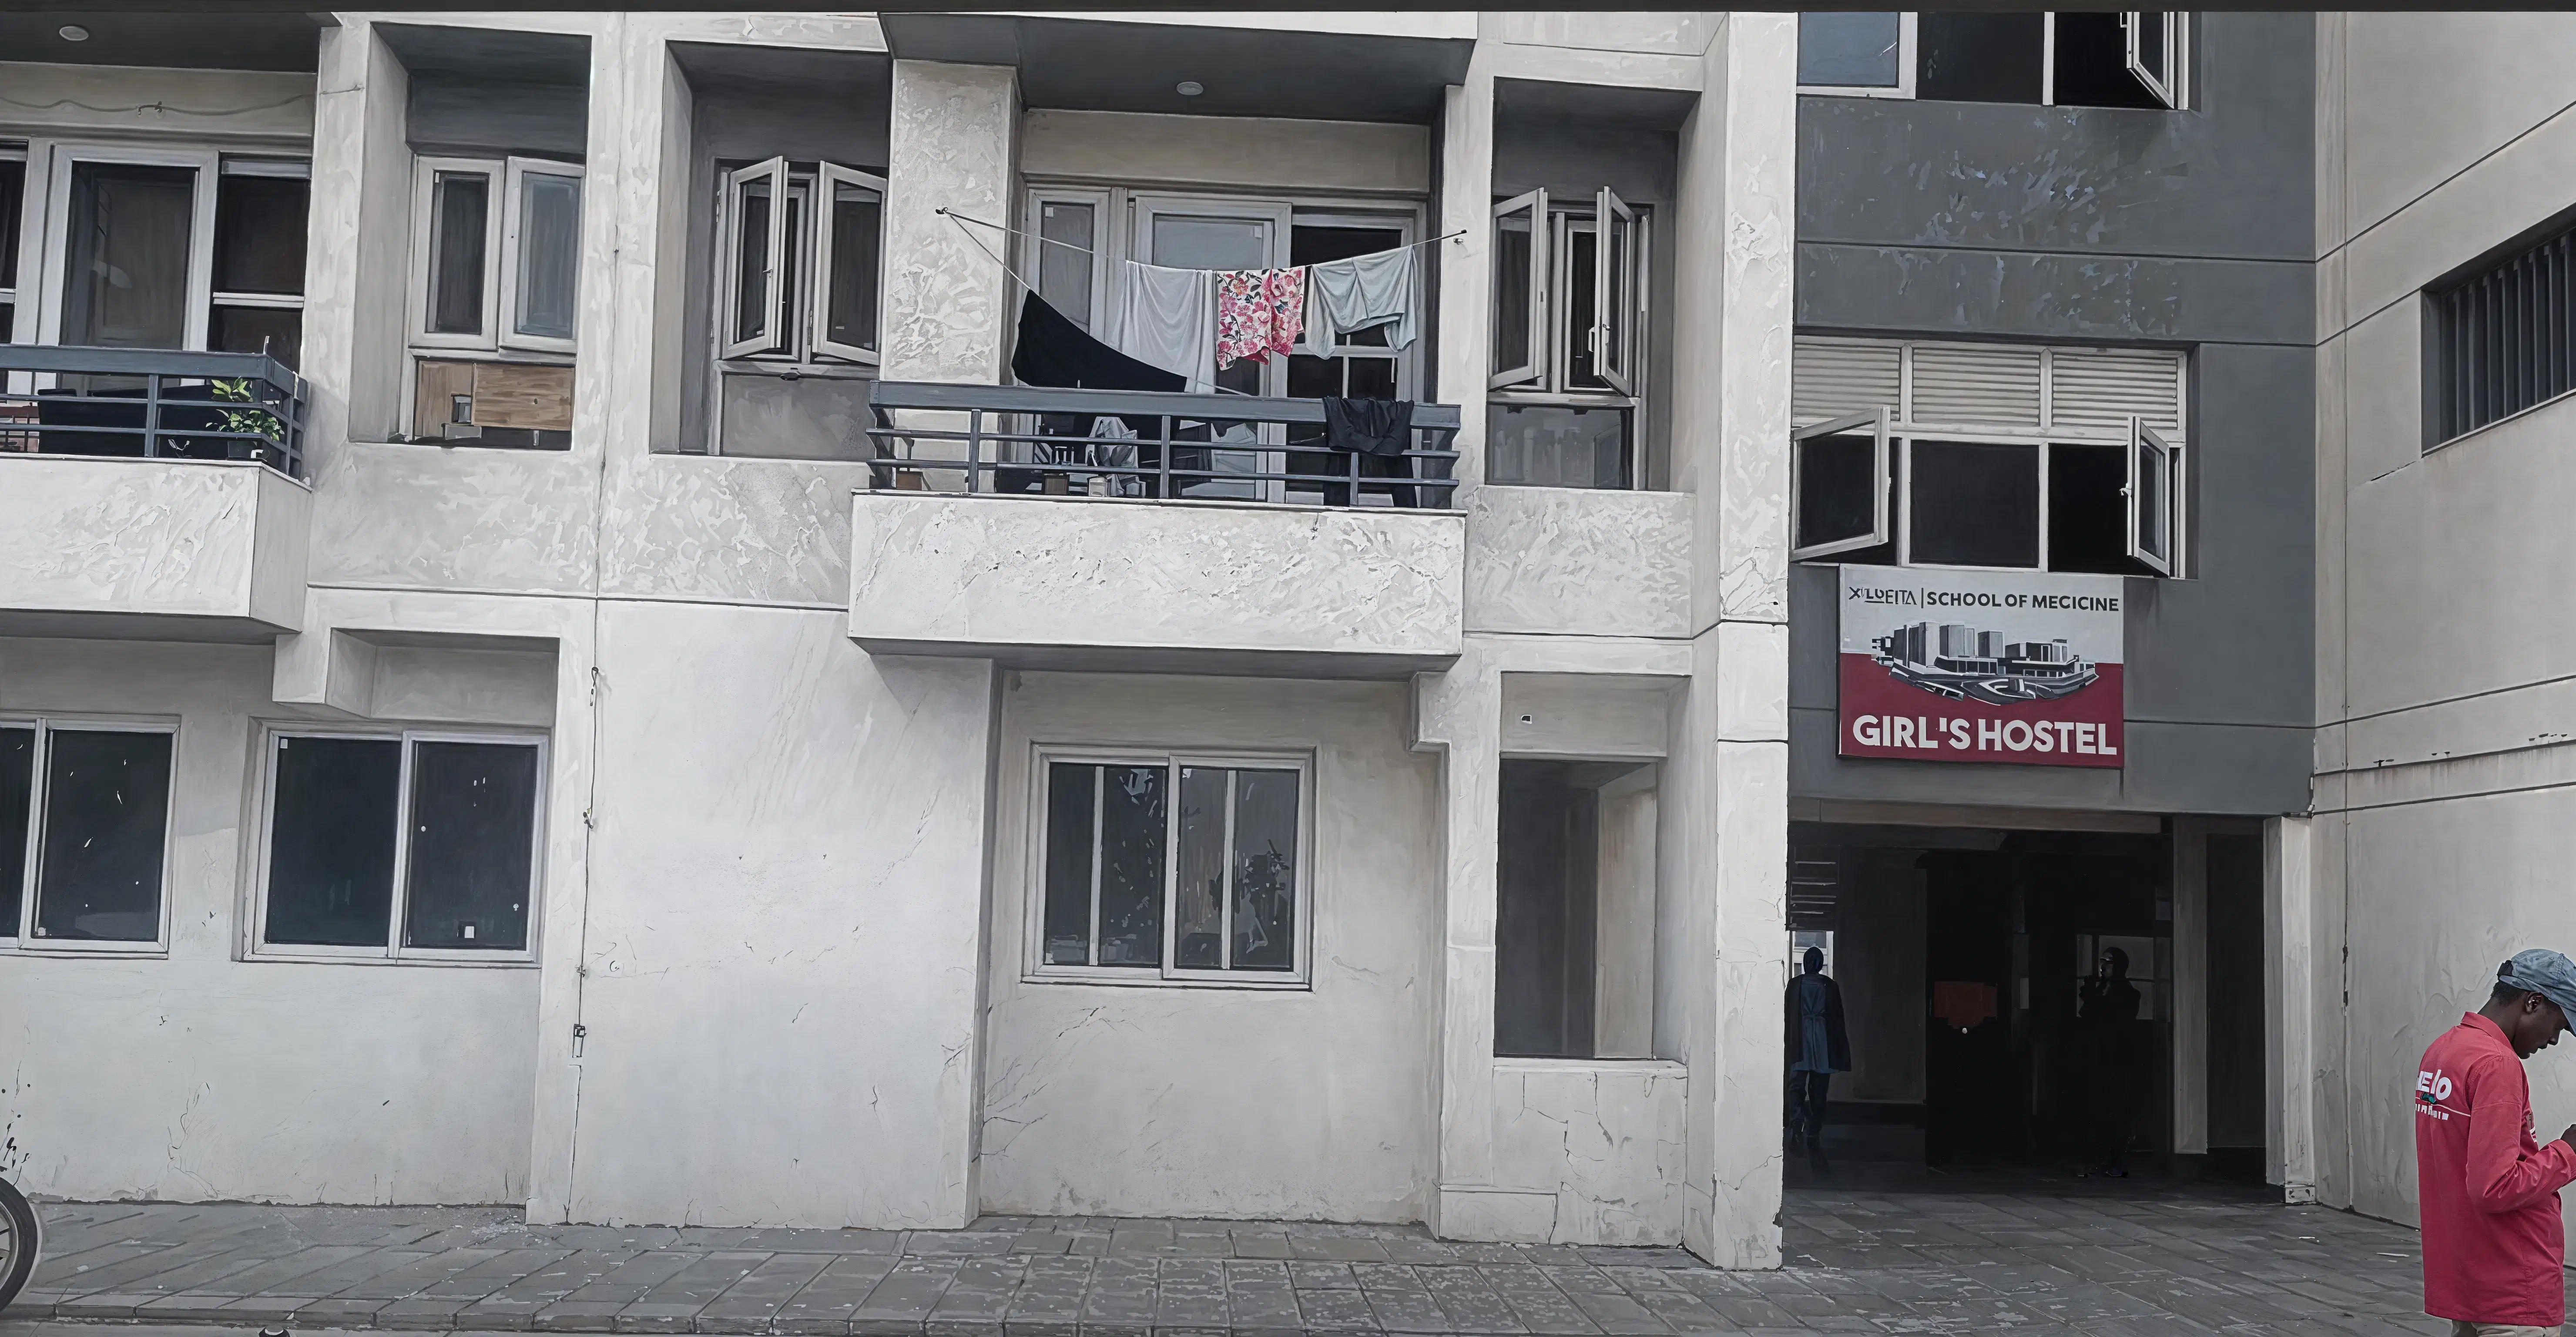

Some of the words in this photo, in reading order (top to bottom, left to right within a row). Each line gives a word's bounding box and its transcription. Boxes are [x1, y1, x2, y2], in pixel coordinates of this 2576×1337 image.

[1927, 591, 2002, 607] SCHOOL
[2005, 594, 2027, 608] OF
[2032, 595, 2119, 611] MECICINE
[1853, 715, 1971, 749] GIRL'S
[1978, 719, 2117, 756] HOSTEL
